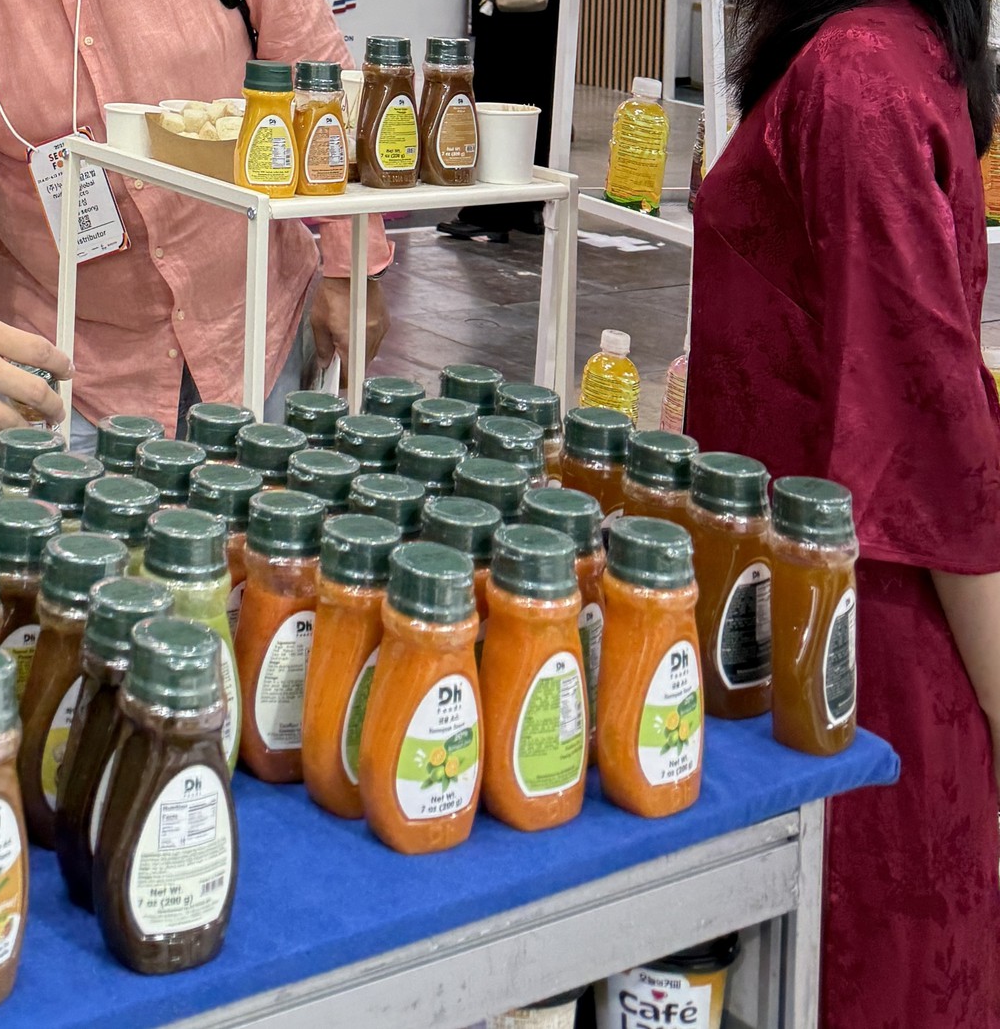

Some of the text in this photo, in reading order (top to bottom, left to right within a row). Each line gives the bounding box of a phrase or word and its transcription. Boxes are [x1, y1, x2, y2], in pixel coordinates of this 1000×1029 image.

[77, 230, 106, 245] istributor
[150, 886, 167, 898] Net
[619, 989, 698, 1025] Café
